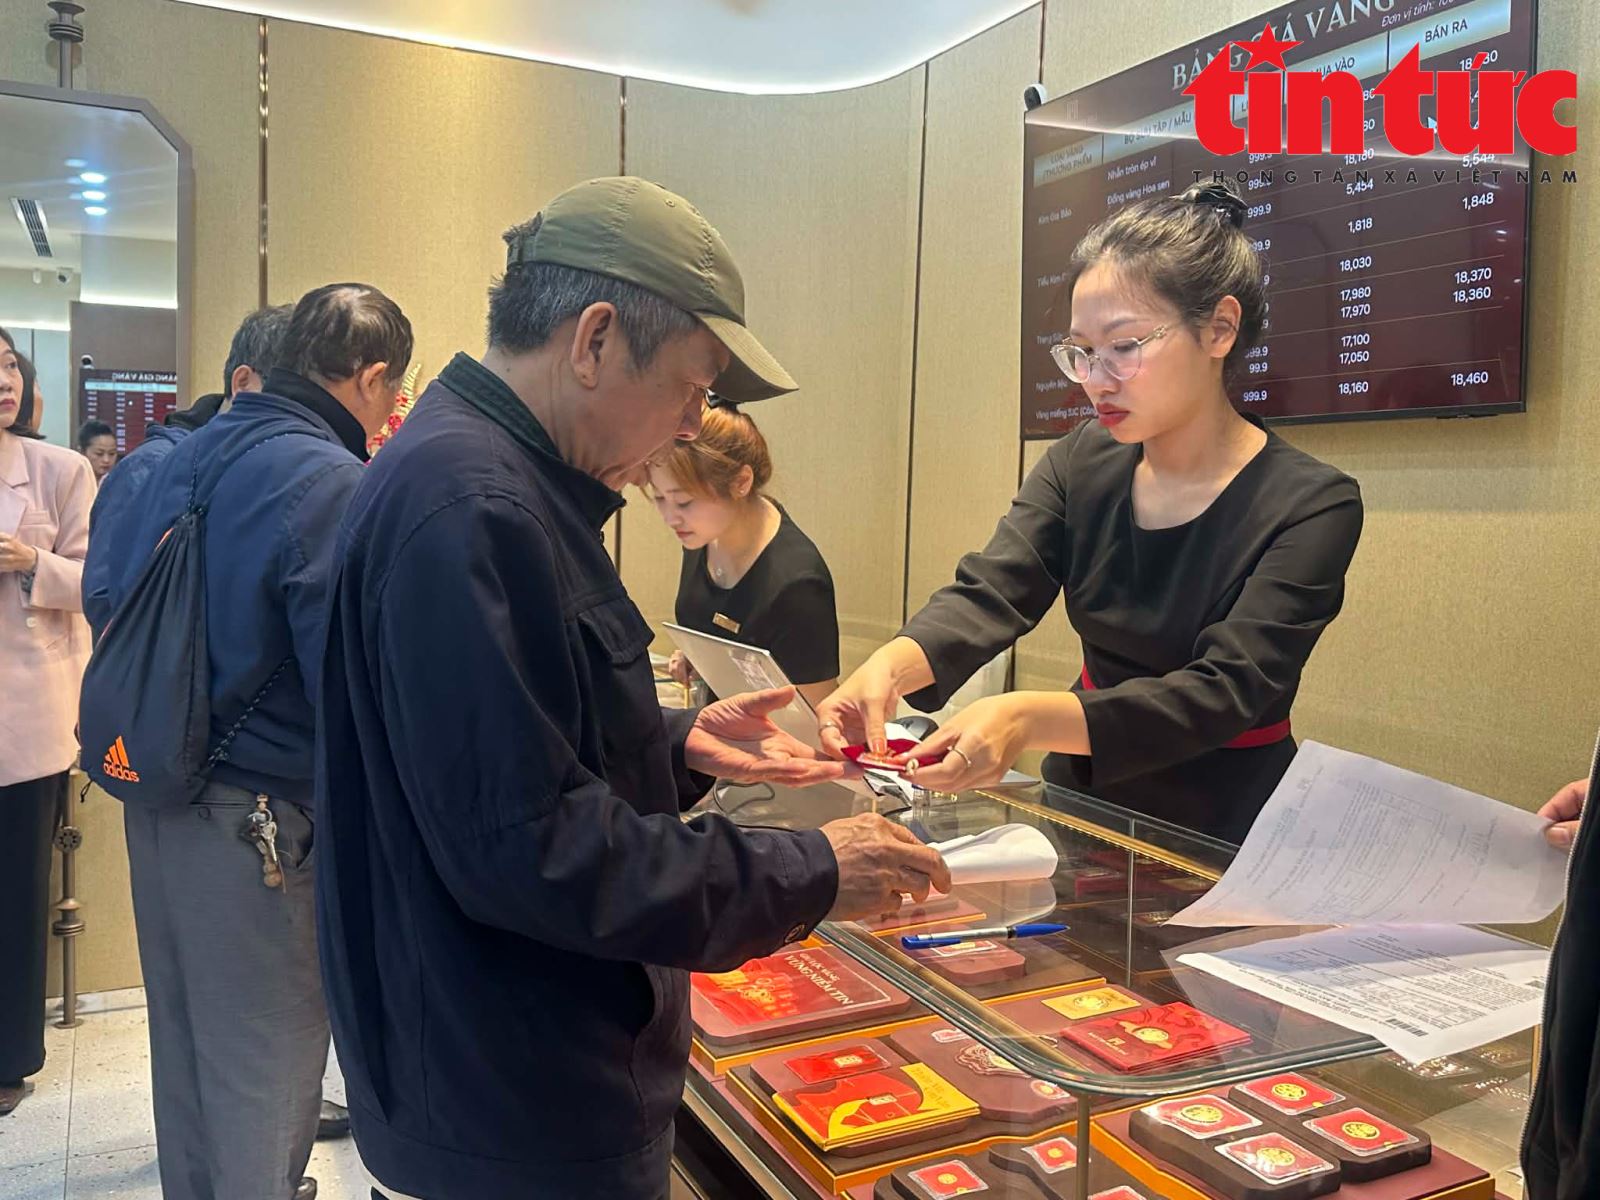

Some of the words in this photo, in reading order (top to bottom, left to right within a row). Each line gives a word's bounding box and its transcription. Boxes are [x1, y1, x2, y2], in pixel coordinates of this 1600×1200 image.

[1425, 23, 1449, 43] BÁN
[1452, 18, 1468, 34] RA
[1142, 182, 1157, 196] Hoa
[1157, 179, 1170, 191] sen
[1247, 203, 1271, 218] 999.9
[1462, 192, 1494, 211] 1,848
[1347, 217, 1373, 233] 1,818
[1339, 256, 1372, 272] 18,030
[1340, 286, 1371, 302] 17,980
[1454, 267, 1492, 285] 18,370
[1340, 303, 1371, 319] 17,970
[1452, 286, 1491, 303] 18,360
[1341, 333, 1370, 349] 17,100
[1339, 350, 1369, 366] 17,050
[1243, 390, 1268, 401] 999.9
[1338, 381, 1369, 396] 18,160
[1450, 371, 1488, 387] 18,460
[829, 990, 854, 1005] TIN
